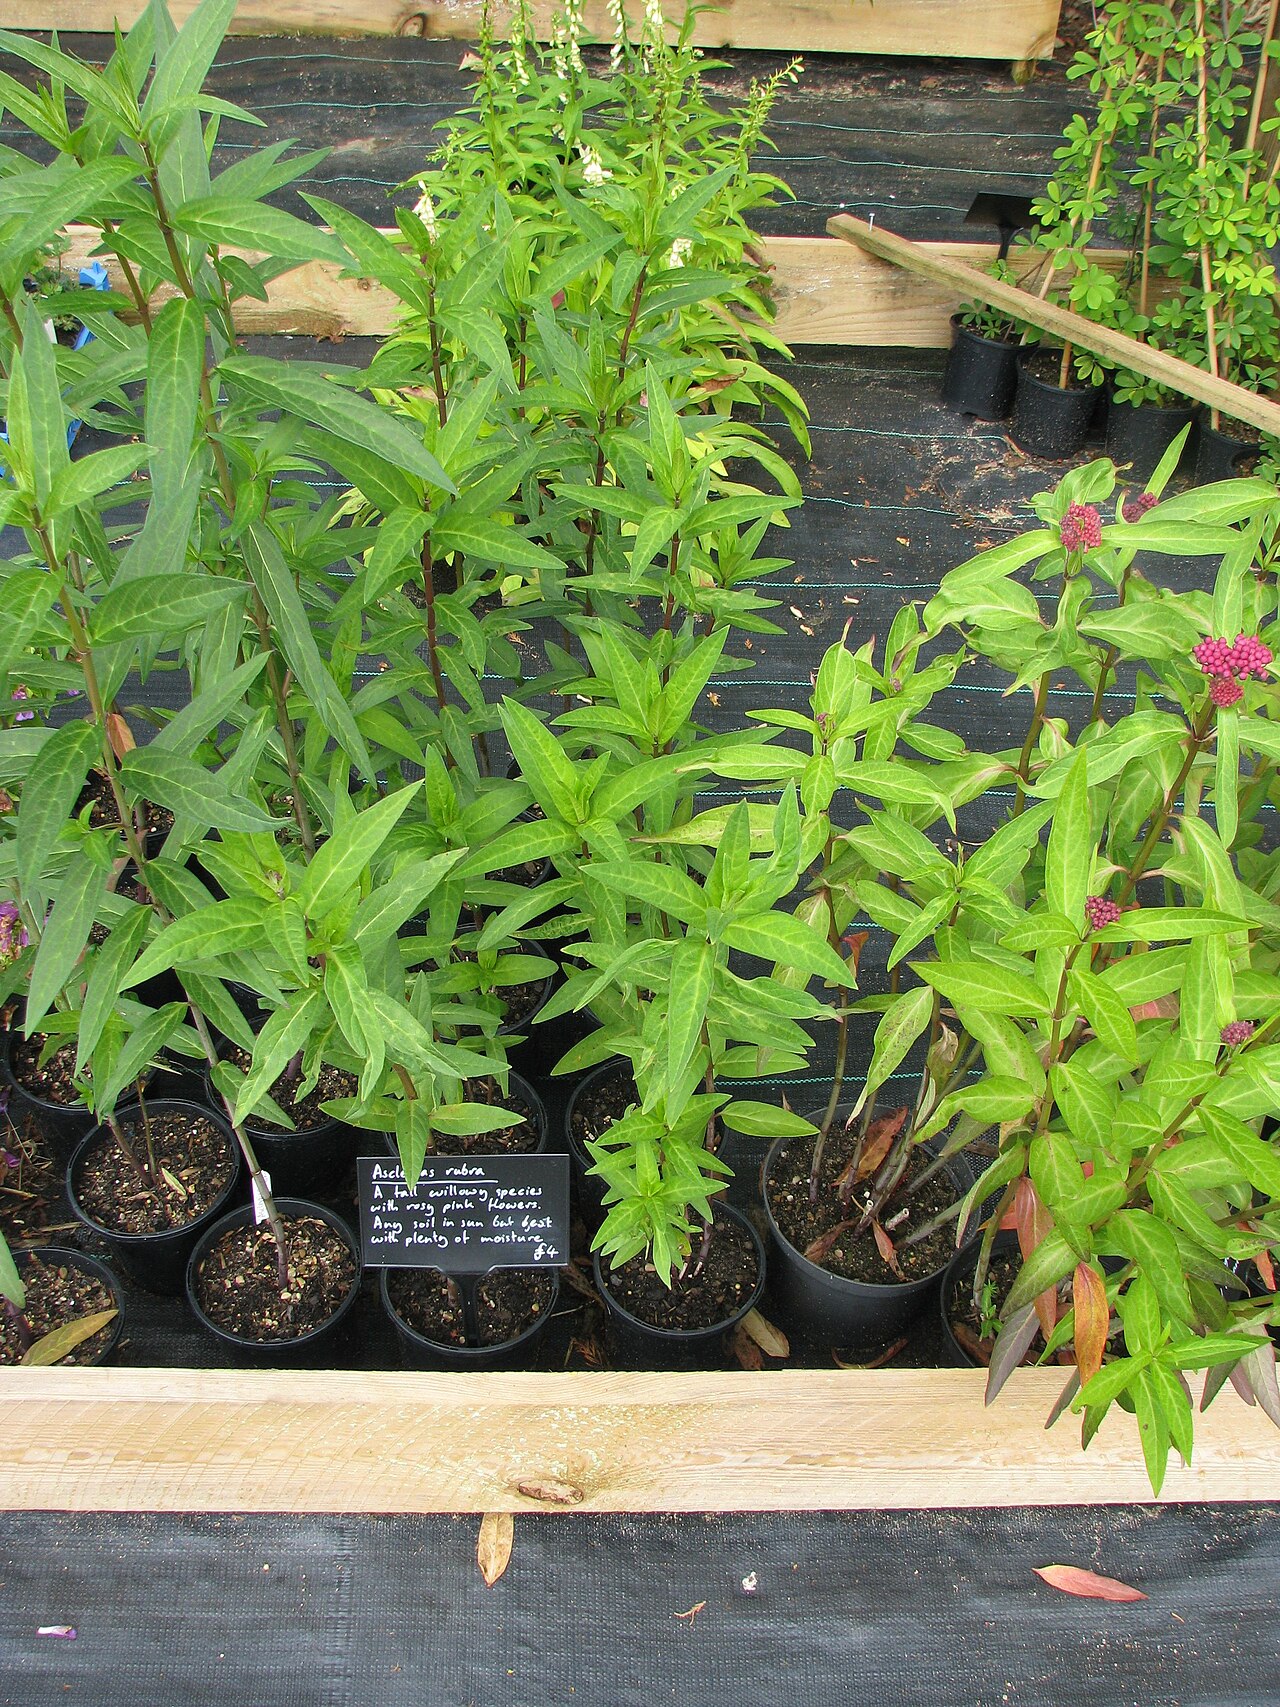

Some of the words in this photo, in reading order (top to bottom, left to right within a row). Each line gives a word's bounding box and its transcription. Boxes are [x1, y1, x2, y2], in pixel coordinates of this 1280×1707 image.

[372, 1163, 435, 1179] Ascleas
[445, 1163, 486, 1176] rubra
[373, 1185, 384, 1199] A
[394, 1185, 418, 1198] tall
[428, 1185, 489, 1201] willowy
[495, 1186, 543, 1200] species
[370, 1199, 399, 1213] with
[406, 1203, 435, 1216] rosy
[442, 1200, 475, 1214] pink
[488, 1198, 542, 1211] flowers.
[373, 1215, 403, 1234] Any
[413, 1216, 435, 1229] soil
[442, 1218, 455, 1227] in
[460, 1219, 484, 1228] sun
[492, 1215, 515, 1228] but
[521, 1215, 553, 1232] best
[370, 1231, 400, 1244] with
[405, 1231, 449, 1249] plenty
[454, 1229, 470, 1244] of
[480, 1230, 544, 1244] moisture
[533, 1243, 560, 1261] £4
